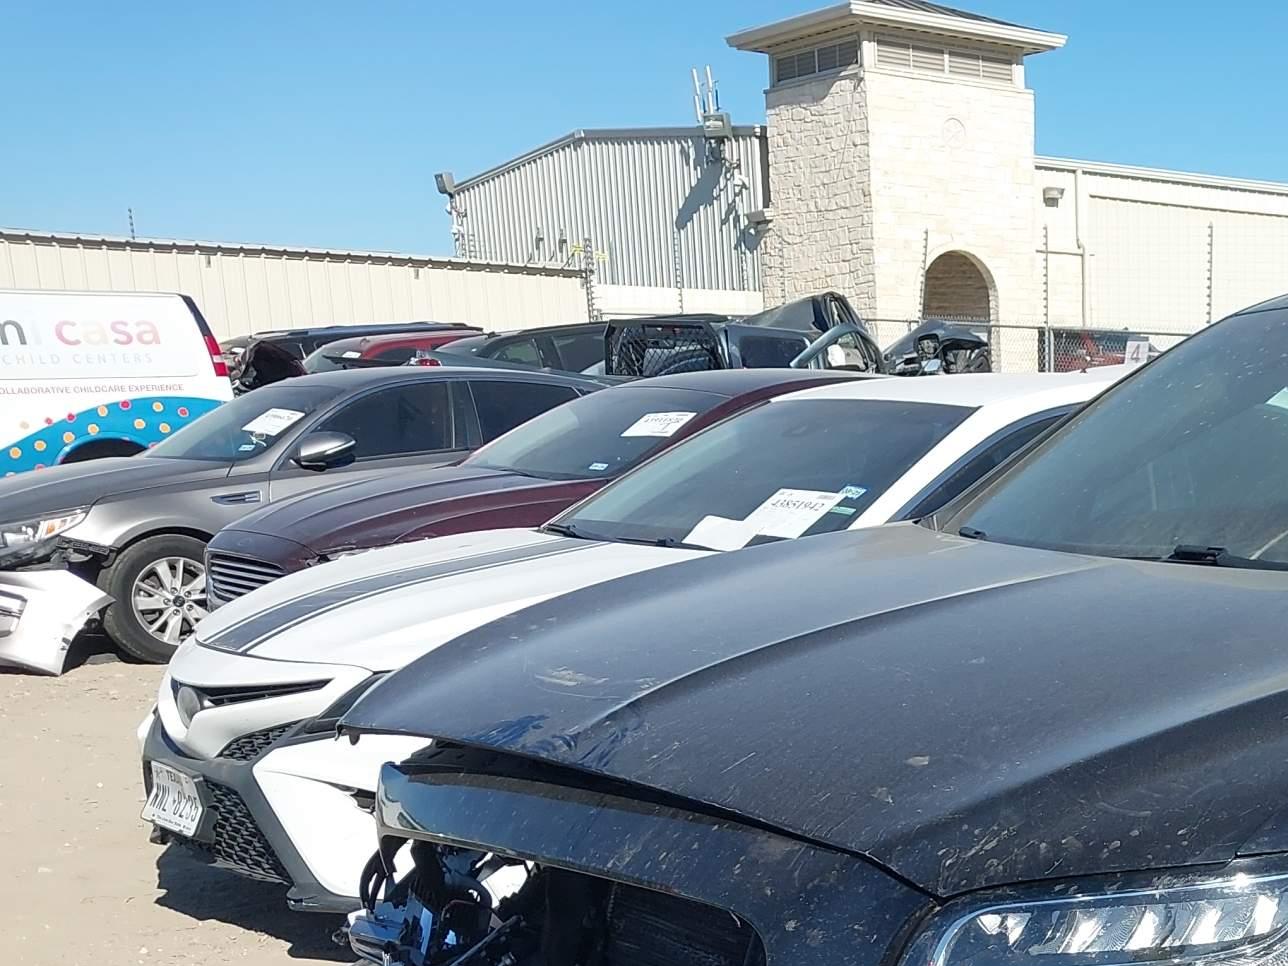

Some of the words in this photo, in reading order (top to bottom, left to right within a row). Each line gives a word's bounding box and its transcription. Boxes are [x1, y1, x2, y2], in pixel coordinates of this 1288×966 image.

[55, 320, 161, 346] casa
[2, 353, 61, 366] CHILD
[72, 352, 153, 365] CENTERS
[1130, 343, 1141, 363] 4
[73, 384, 126, 394] CHILDCARE
[128, 383, 184, 393] EXPERIENCE
